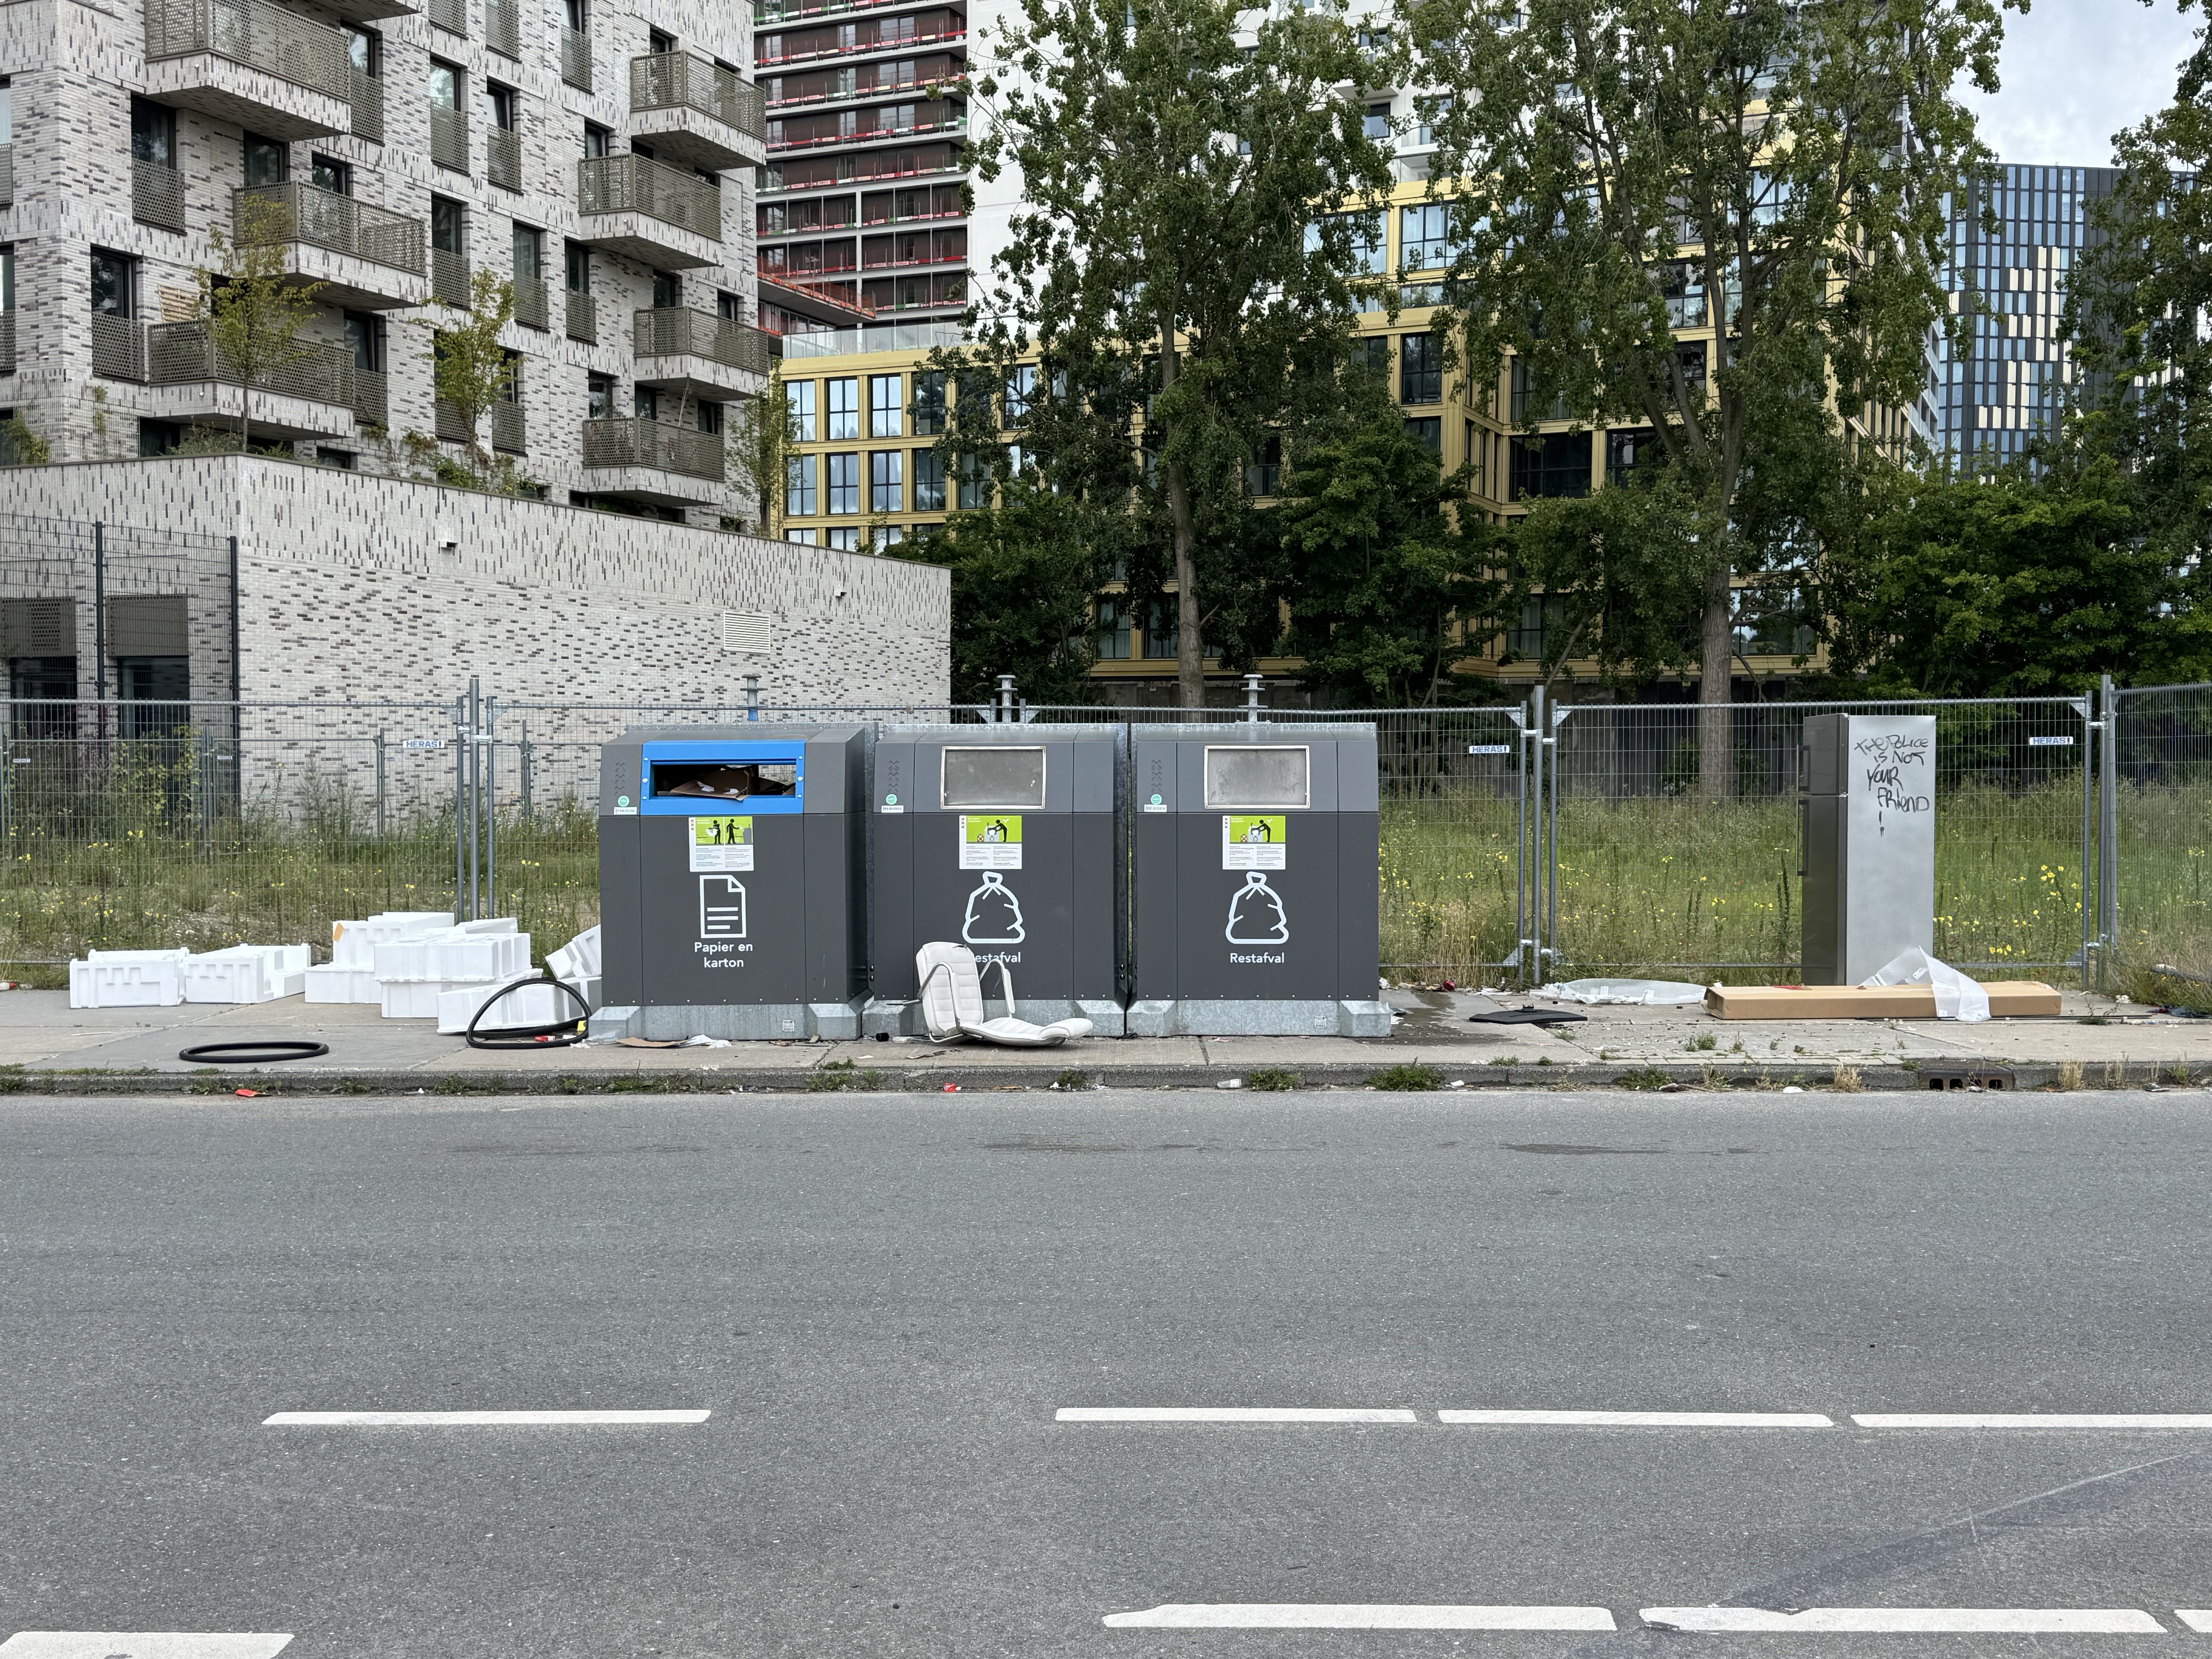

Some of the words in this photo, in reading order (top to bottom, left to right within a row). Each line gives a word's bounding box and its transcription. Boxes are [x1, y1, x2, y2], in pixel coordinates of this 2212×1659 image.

[694, 941, 734, 955] Papier
[738, 943, 753, 951] en
[704, 957, 744, 968] karton
[975, 951, 1021, 963] estafval
[1230, 952, 1285, 963] Restafval
